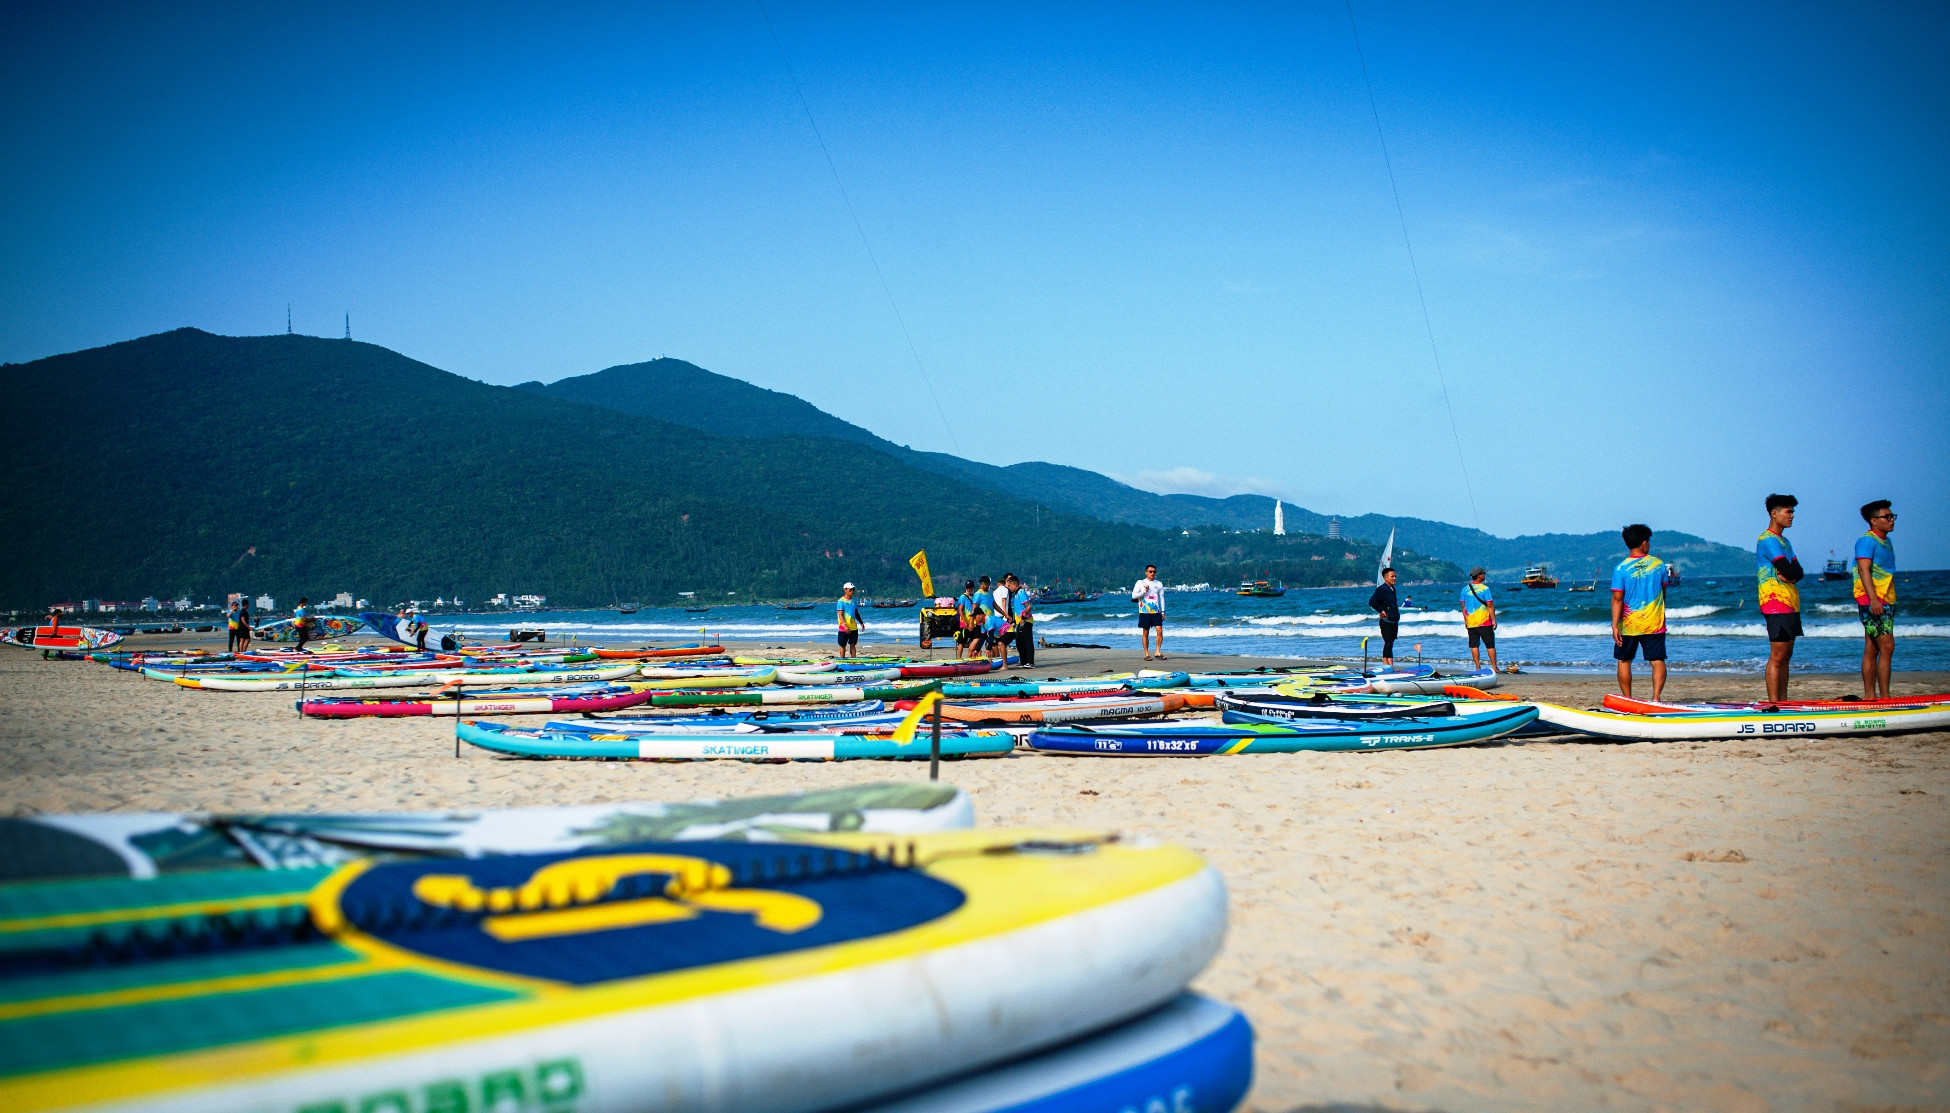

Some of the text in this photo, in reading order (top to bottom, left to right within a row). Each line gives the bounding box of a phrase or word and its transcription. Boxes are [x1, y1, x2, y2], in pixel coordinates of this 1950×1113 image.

[1100, 707, 1134, 716] MAGMA
[1737, 722, 1816, 734] JS BOARD
[1382, 734, 1434, 744] TRANS-E
[702, 745, 769, 755] SKATINGER
